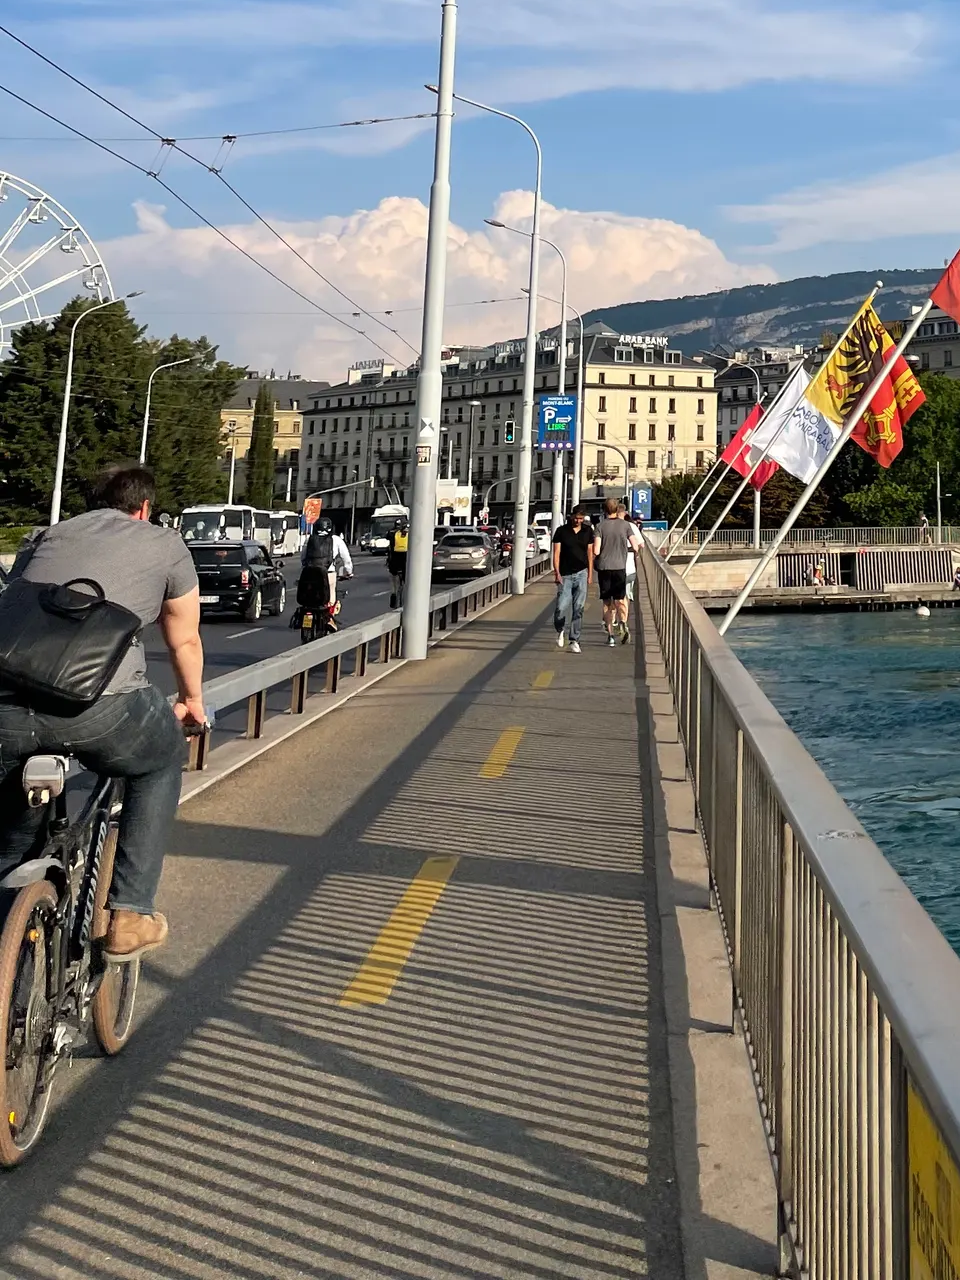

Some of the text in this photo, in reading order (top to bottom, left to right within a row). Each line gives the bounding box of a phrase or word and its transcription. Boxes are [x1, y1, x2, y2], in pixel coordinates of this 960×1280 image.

[618, 334, 643, 344] ARAB
[644, 336, 669, 347] BANK
[547, 423, 567, 431] LIBRE
[804, 410, 821, 429] BOL
[795, 419, 833, 452] MIRABAU
